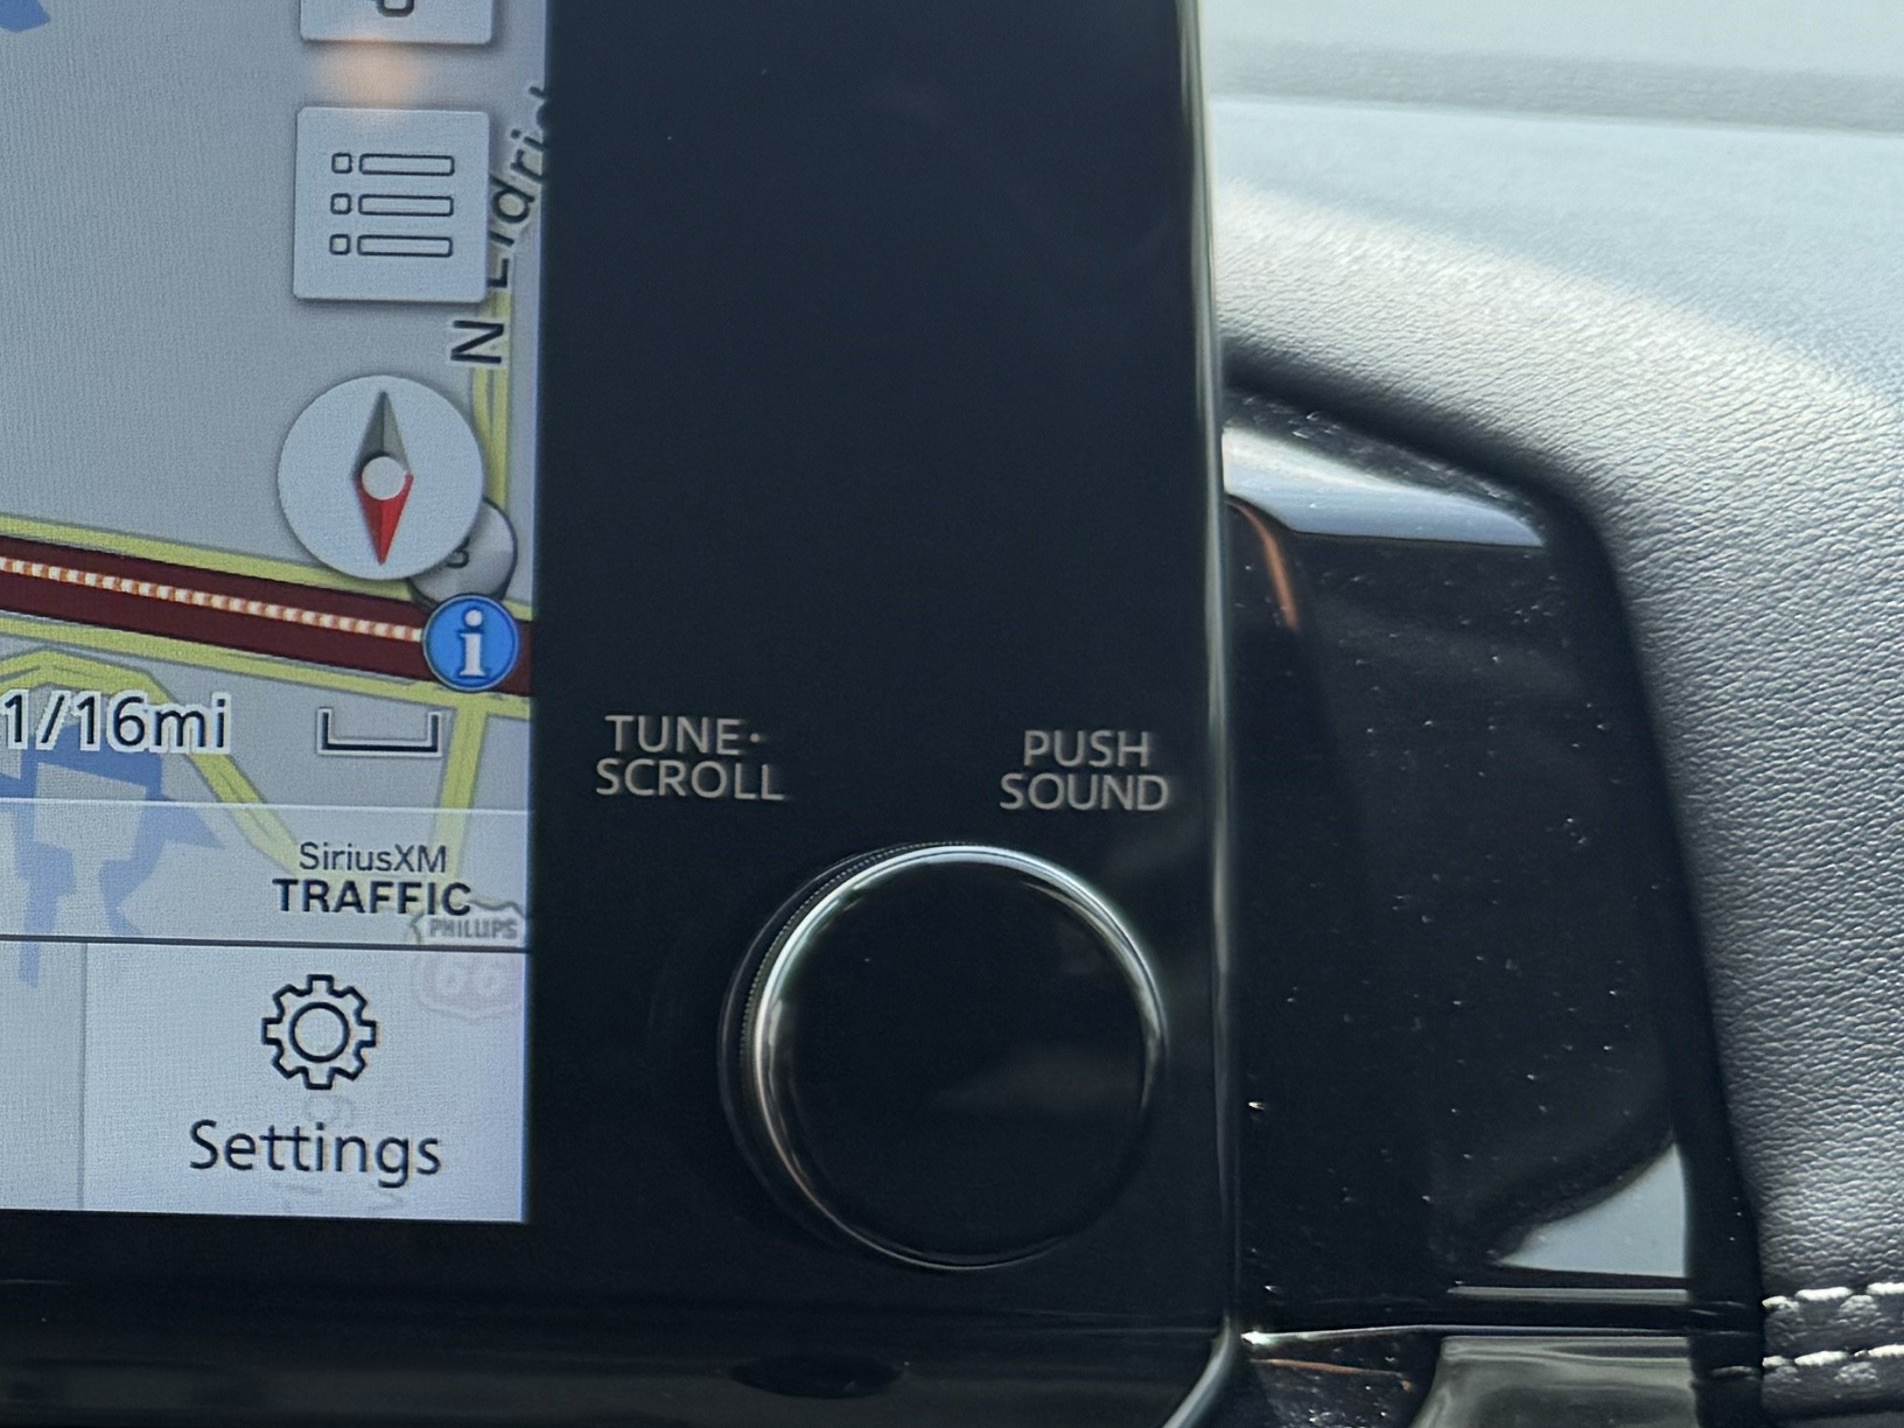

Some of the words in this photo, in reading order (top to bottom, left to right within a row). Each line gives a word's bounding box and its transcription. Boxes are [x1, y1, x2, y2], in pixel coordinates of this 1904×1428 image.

[452, 321, 504, 364] N
[6, 695, 225, 748] 1/16mi
[1025, 730, 1150, 767] PUSH
[596, 758, 785, 801] SCROLL
[1001, 773, 1169, 810] SOUND
[300, 842, 446, 872] SiriusXM
[273, 879, 471, 916] TRAFFIC
[430, 918, 517, 939] PHILLIPS
[191, 1120, 441, 1188] Settings
